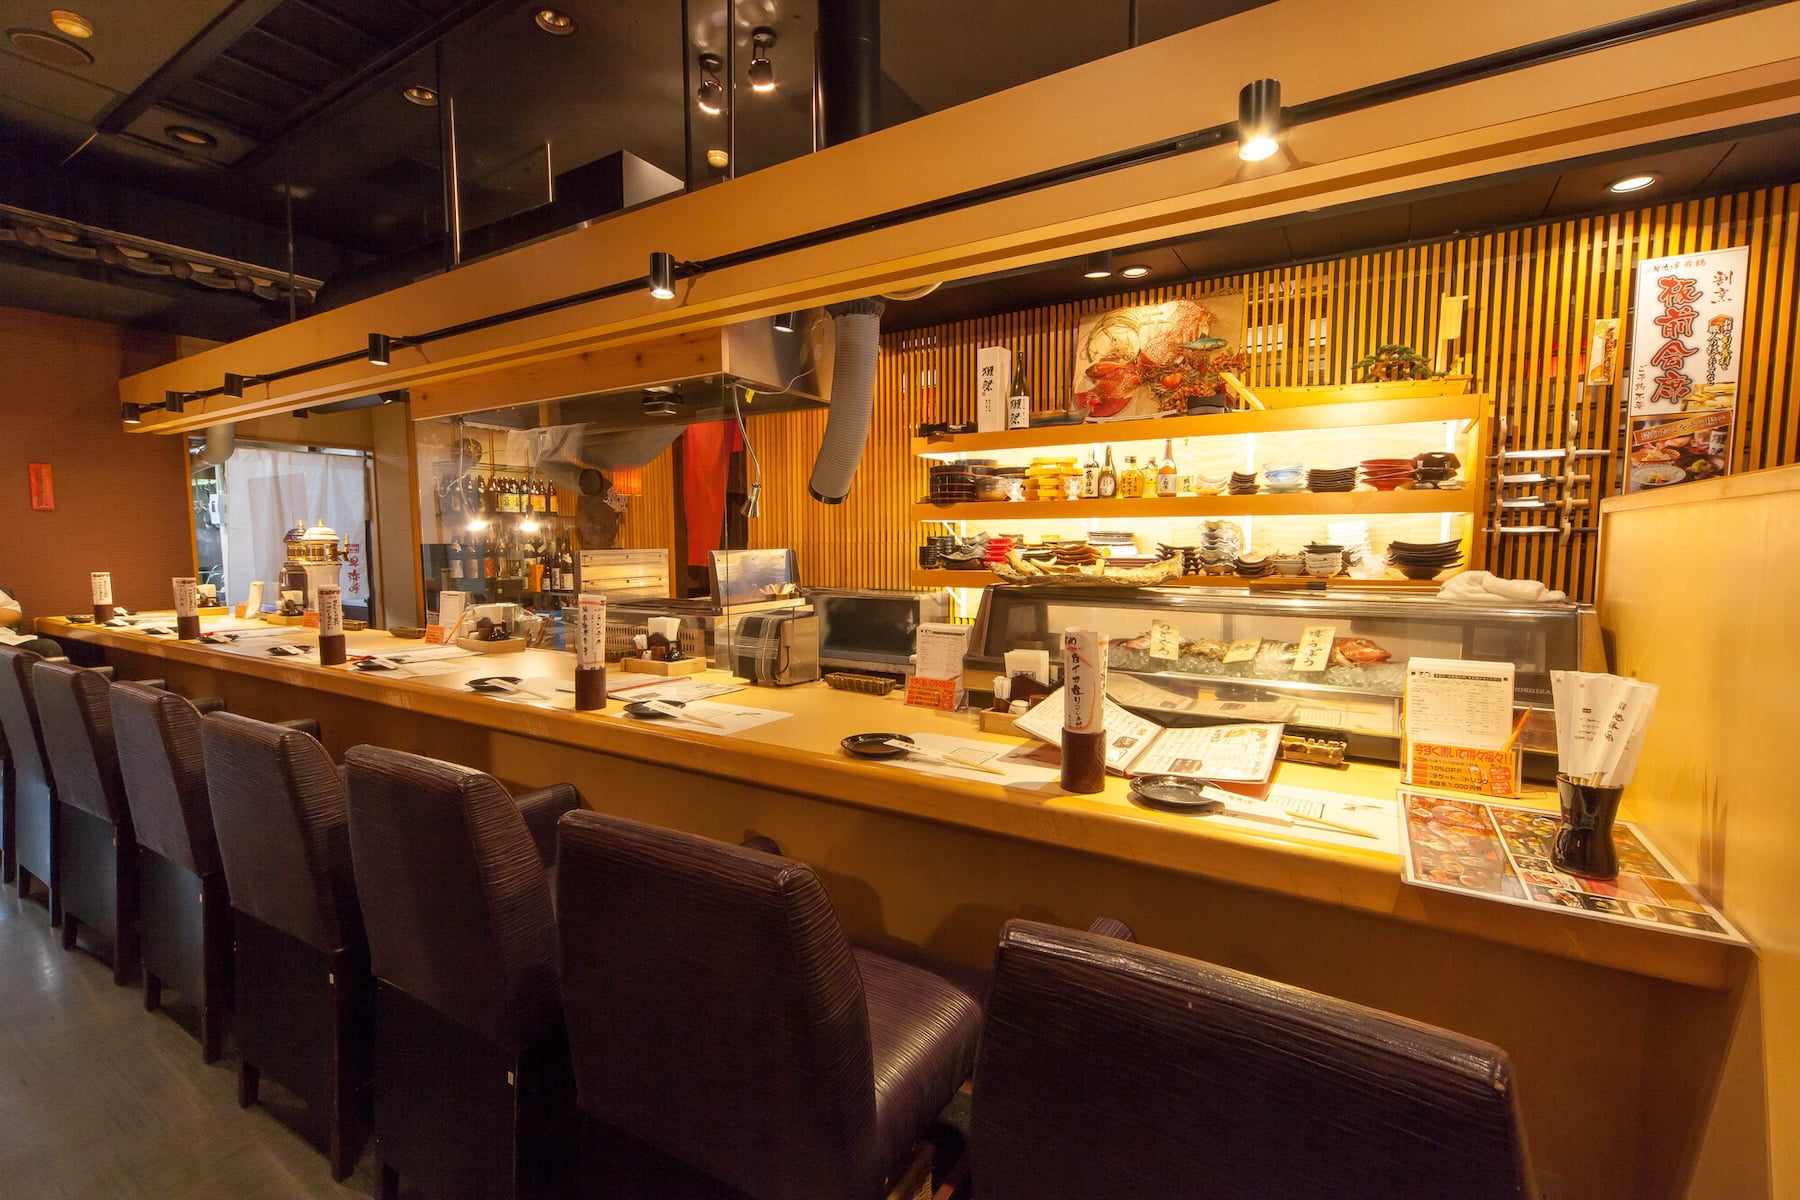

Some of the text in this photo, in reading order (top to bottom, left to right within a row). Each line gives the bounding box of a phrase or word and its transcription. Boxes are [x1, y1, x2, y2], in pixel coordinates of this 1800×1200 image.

[1651, 275, 1703, 404] 板前会席
[981, 365, 994, 392] 獺祭
[1010, 398, 1021, 425] 獺祭
